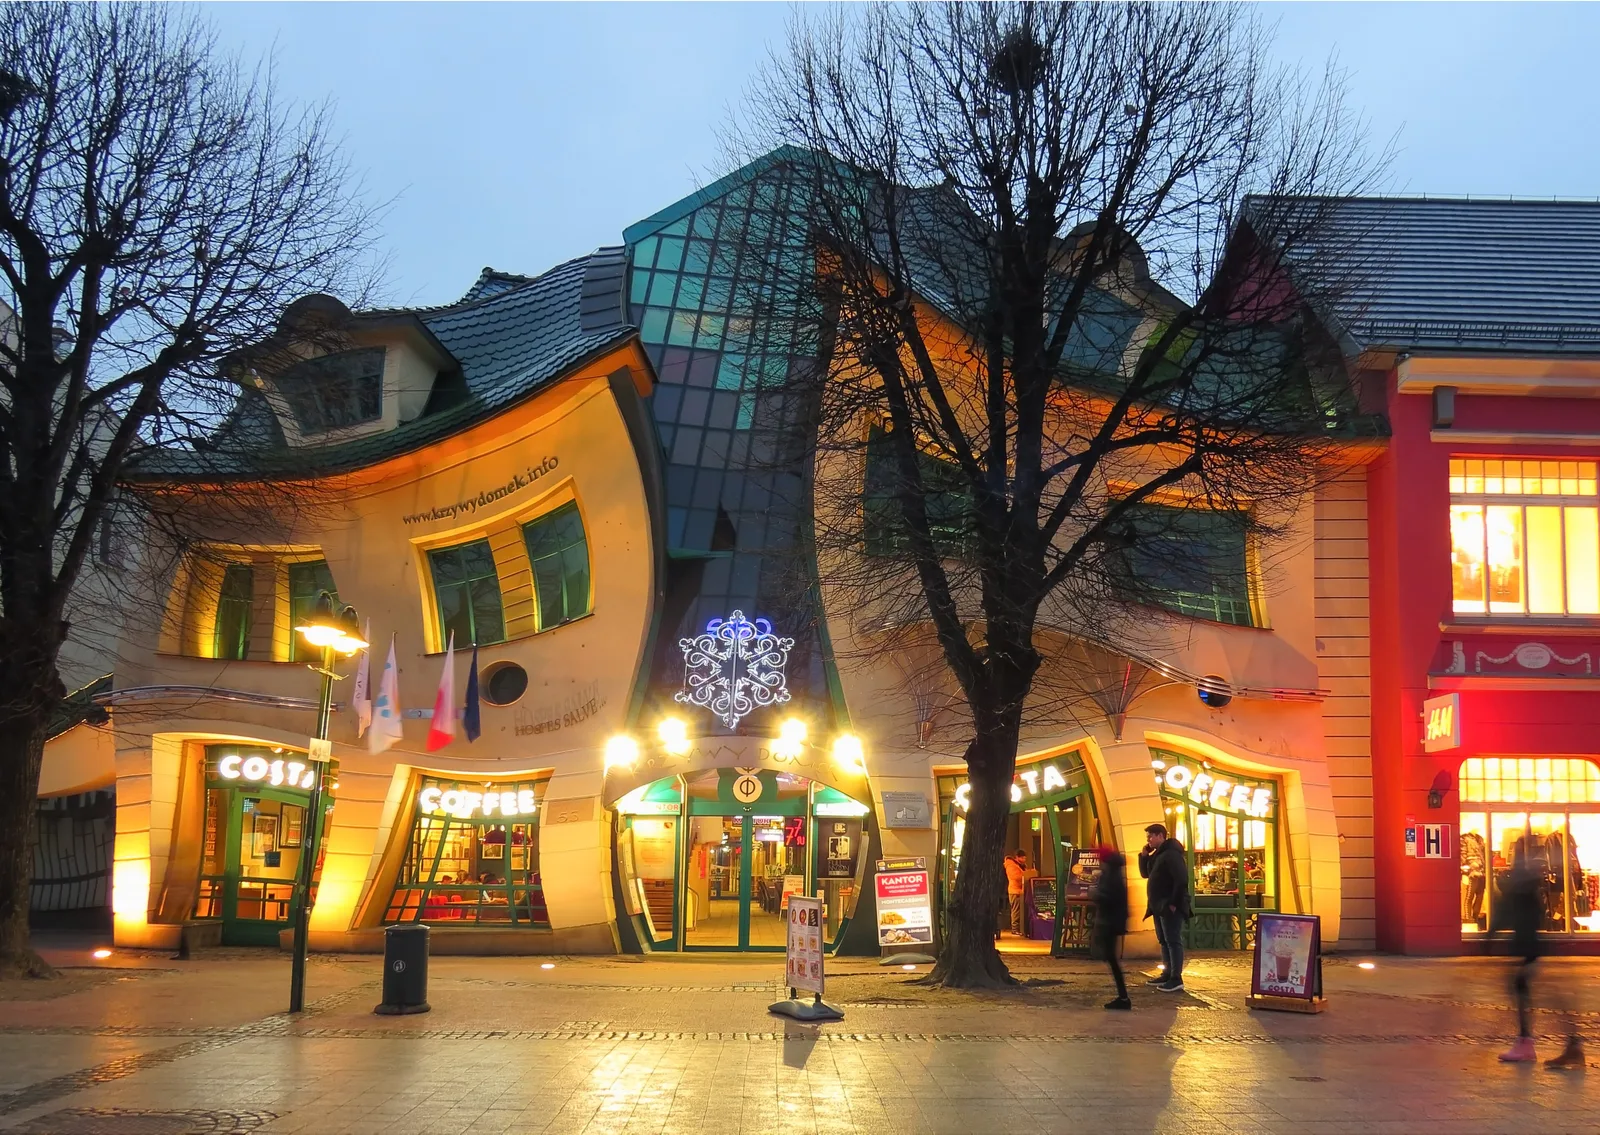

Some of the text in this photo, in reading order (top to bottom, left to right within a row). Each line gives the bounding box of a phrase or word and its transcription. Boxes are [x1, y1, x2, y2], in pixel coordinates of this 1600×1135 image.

[403, 455, 559, 525] www.krzywydomek.info
[514, 718, 561, 737] HOSPES
[1427, 704, 1453, 741] H&M
[419, 786, 537, 818] COFFEE
[881, 875, 923, 886] KANTOR
[1268, 984, 1296, 994] COSTA
